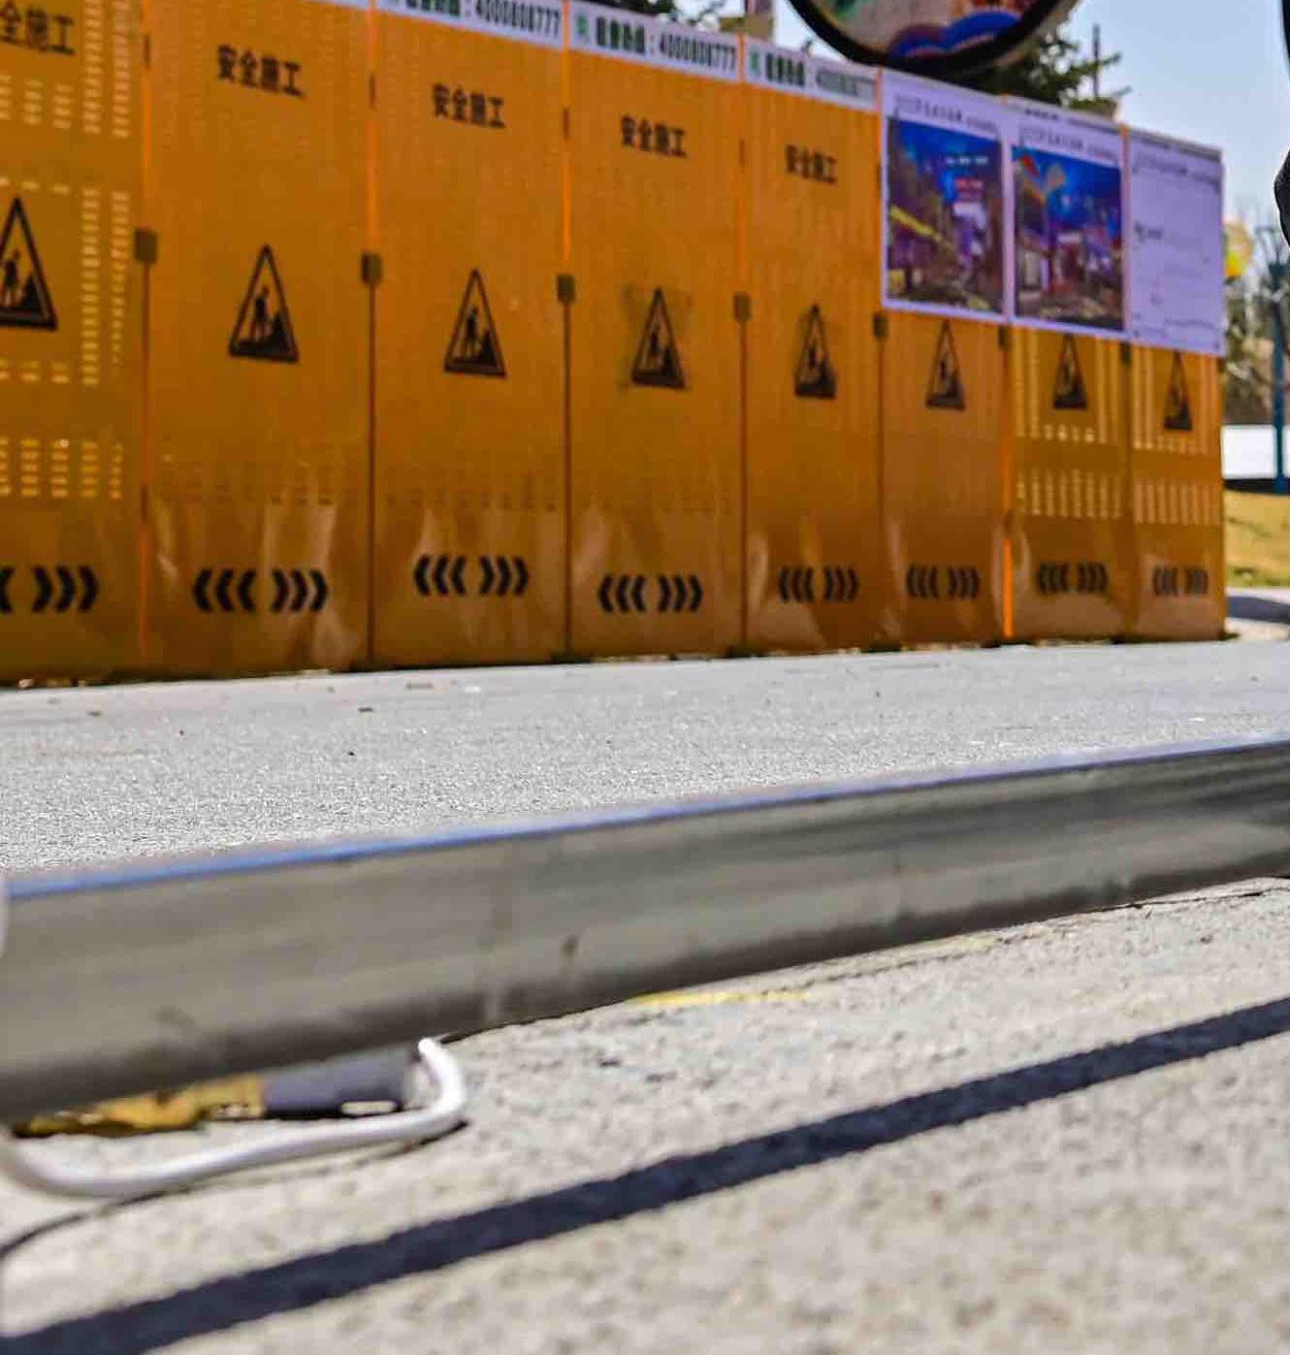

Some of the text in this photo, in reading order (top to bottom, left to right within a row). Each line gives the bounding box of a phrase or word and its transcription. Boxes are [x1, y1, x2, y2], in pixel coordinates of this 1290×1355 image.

[217, 44, 307, 100] 安全施工
[431, 83, 507, 130] 安全施工
